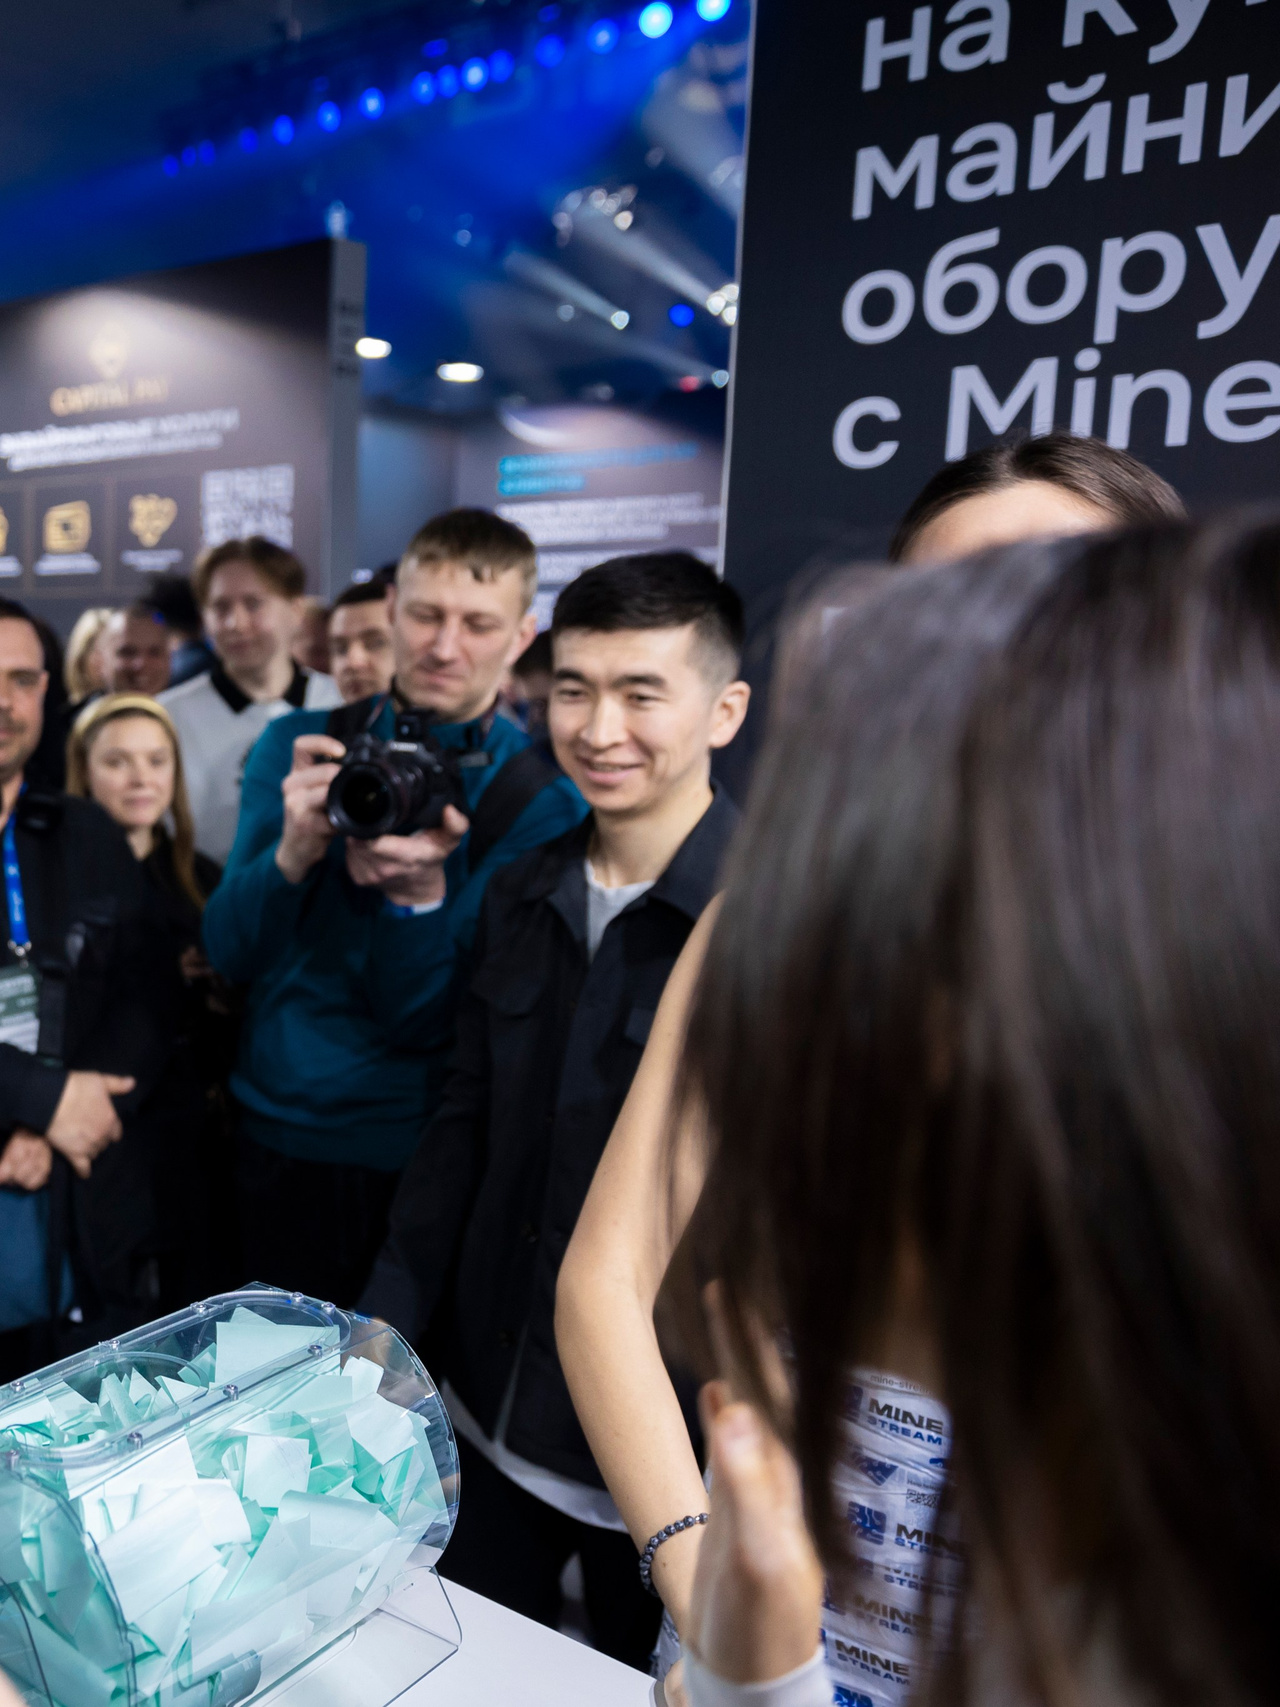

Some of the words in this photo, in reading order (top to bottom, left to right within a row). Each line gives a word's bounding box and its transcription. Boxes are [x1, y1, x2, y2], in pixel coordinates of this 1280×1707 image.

[861, 0, 1011, 92] на
[1062, 0, 1267, 64] ку
[841, 214, 1280, 345] обору
[944, 347, 1280, 462] Mine
[867, 1415, 943, 1446] STREAM
[868, 1397, 944, 1435] MINE
[835, 1639, 910, 1677] MINE
[837, 1653, 910, 1686] STREAM
